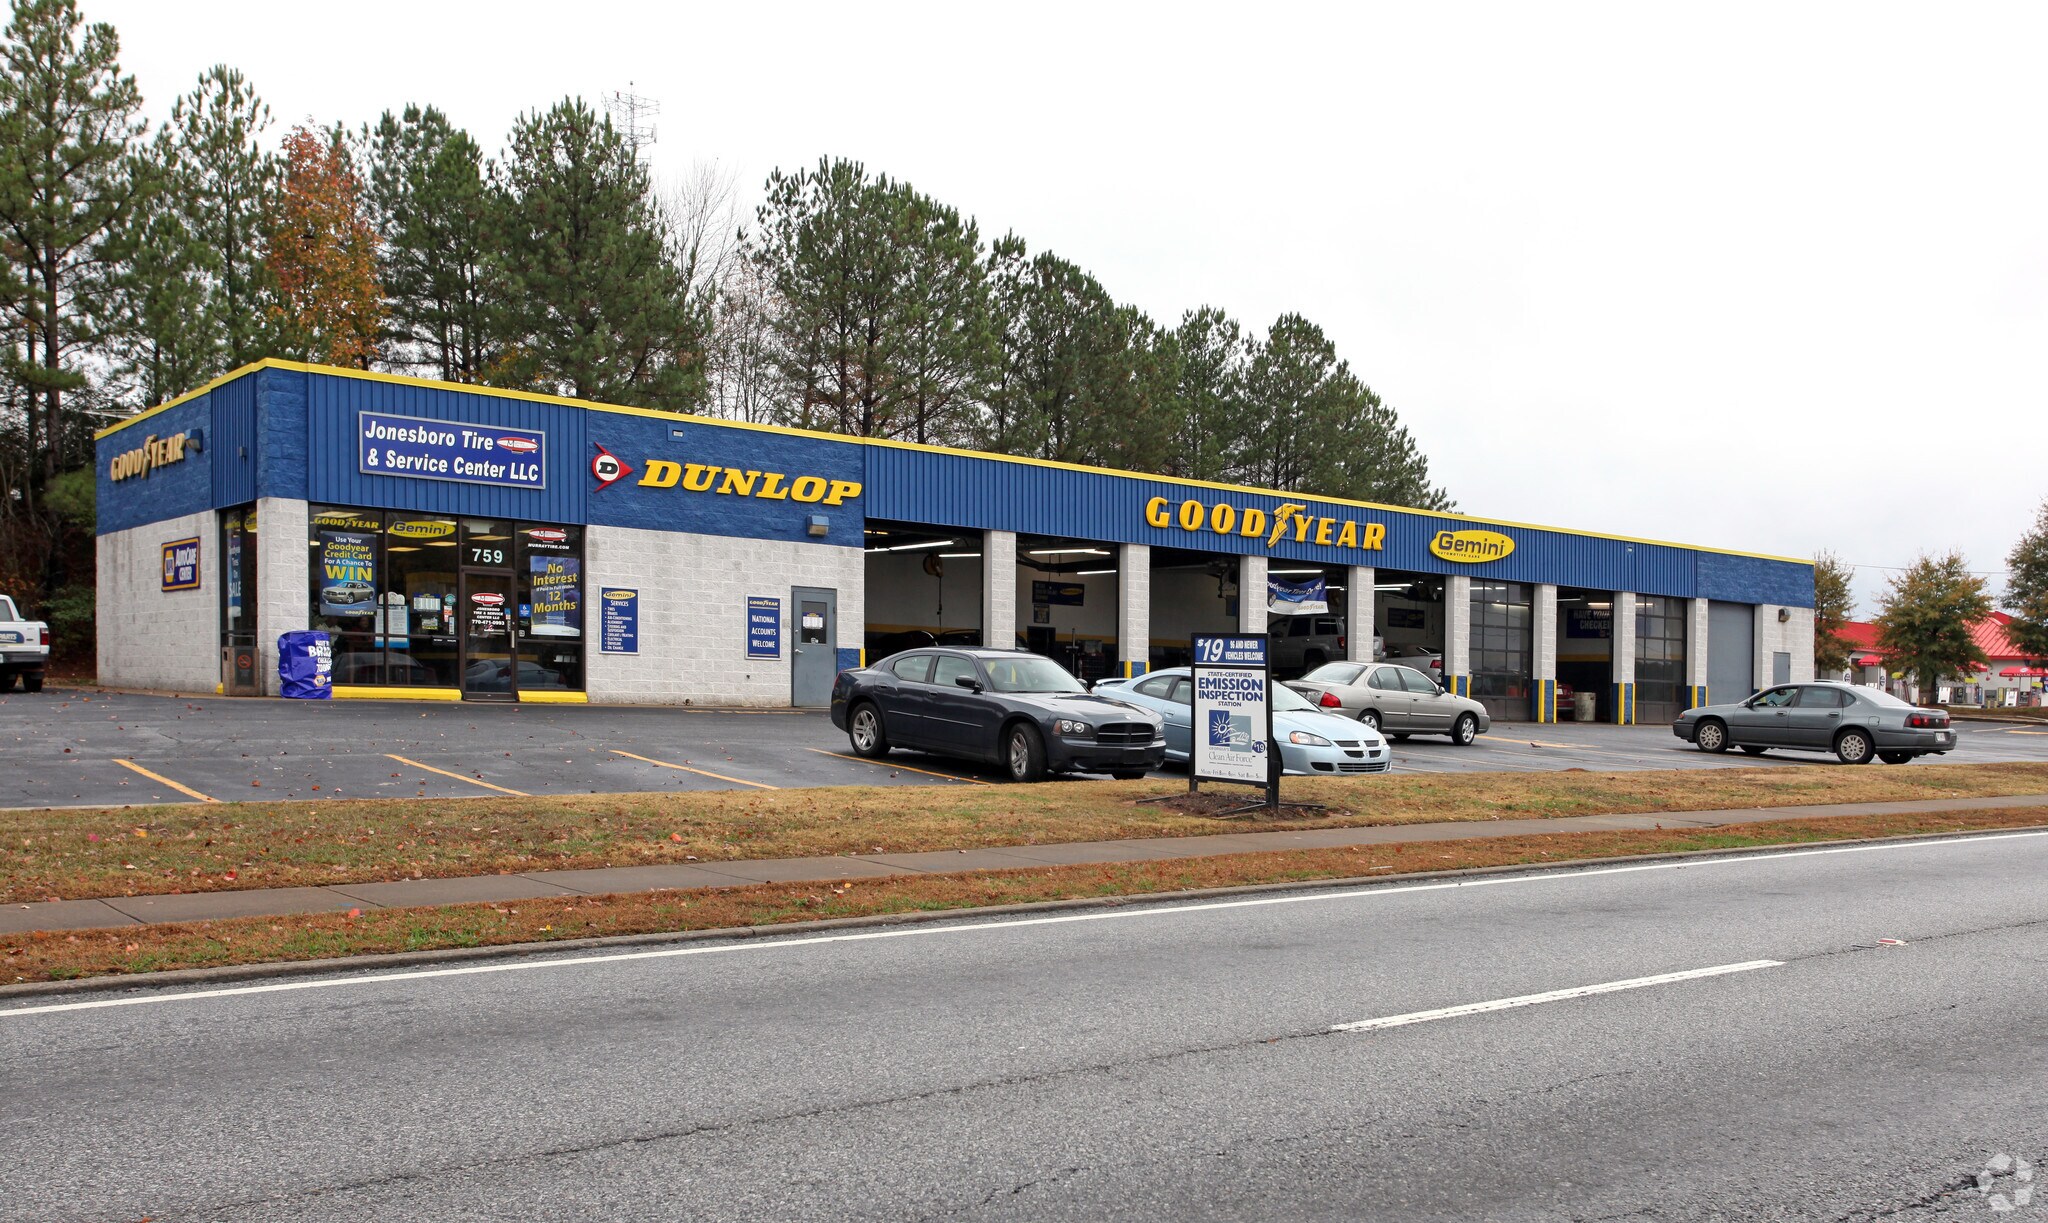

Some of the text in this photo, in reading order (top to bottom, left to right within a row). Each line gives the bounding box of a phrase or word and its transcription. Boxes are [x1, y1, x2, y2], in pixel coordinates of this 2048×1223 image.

[365, 420, 494, 450] Jonesboro Tire
[110, 432, 186, 481] GOODYEAR
[367, 448, 538, 482] & Service Center LLC
[598, 461, 618, 475] D
[637, 459, 862, 506] DUNLOP
[314, 516, 379, 529] GOODYEAR
[393, 520, 448, 535] Gemini
[1145, 496, 1386, 551] GOODYEAR
[328, 542, 370, 552] Goodyear
[1438, 532, 1505, 556] Gemini
[324, 550, 372, 560] Credit Card
[472, 548, 503, 564] 759
[324, 564, 372, 582] WIN
[547, 563, 564, 574] No
[533, 572, 578, 586] Interest
[228, 581, 241, 598] SALE
[548, 590, 561, 602] 12
[752, 614, 776, 624] NATIONAL
[752, 628, 776, 636] ACCOUNTS
[752, 640, 776, 648] WELCOME
[1197, 638, 1224, 662] $19
[1230, 640, 1258, 650] 96 AND NEWER
[1225, 651, 1264, 660] VEHICLES WELCOME
[1198, 677, 1264, 691] EMISSION
[1198, 690, 1264, 702] INSPECTION
[1208, 752, 1252, 763] Clean Air Force
